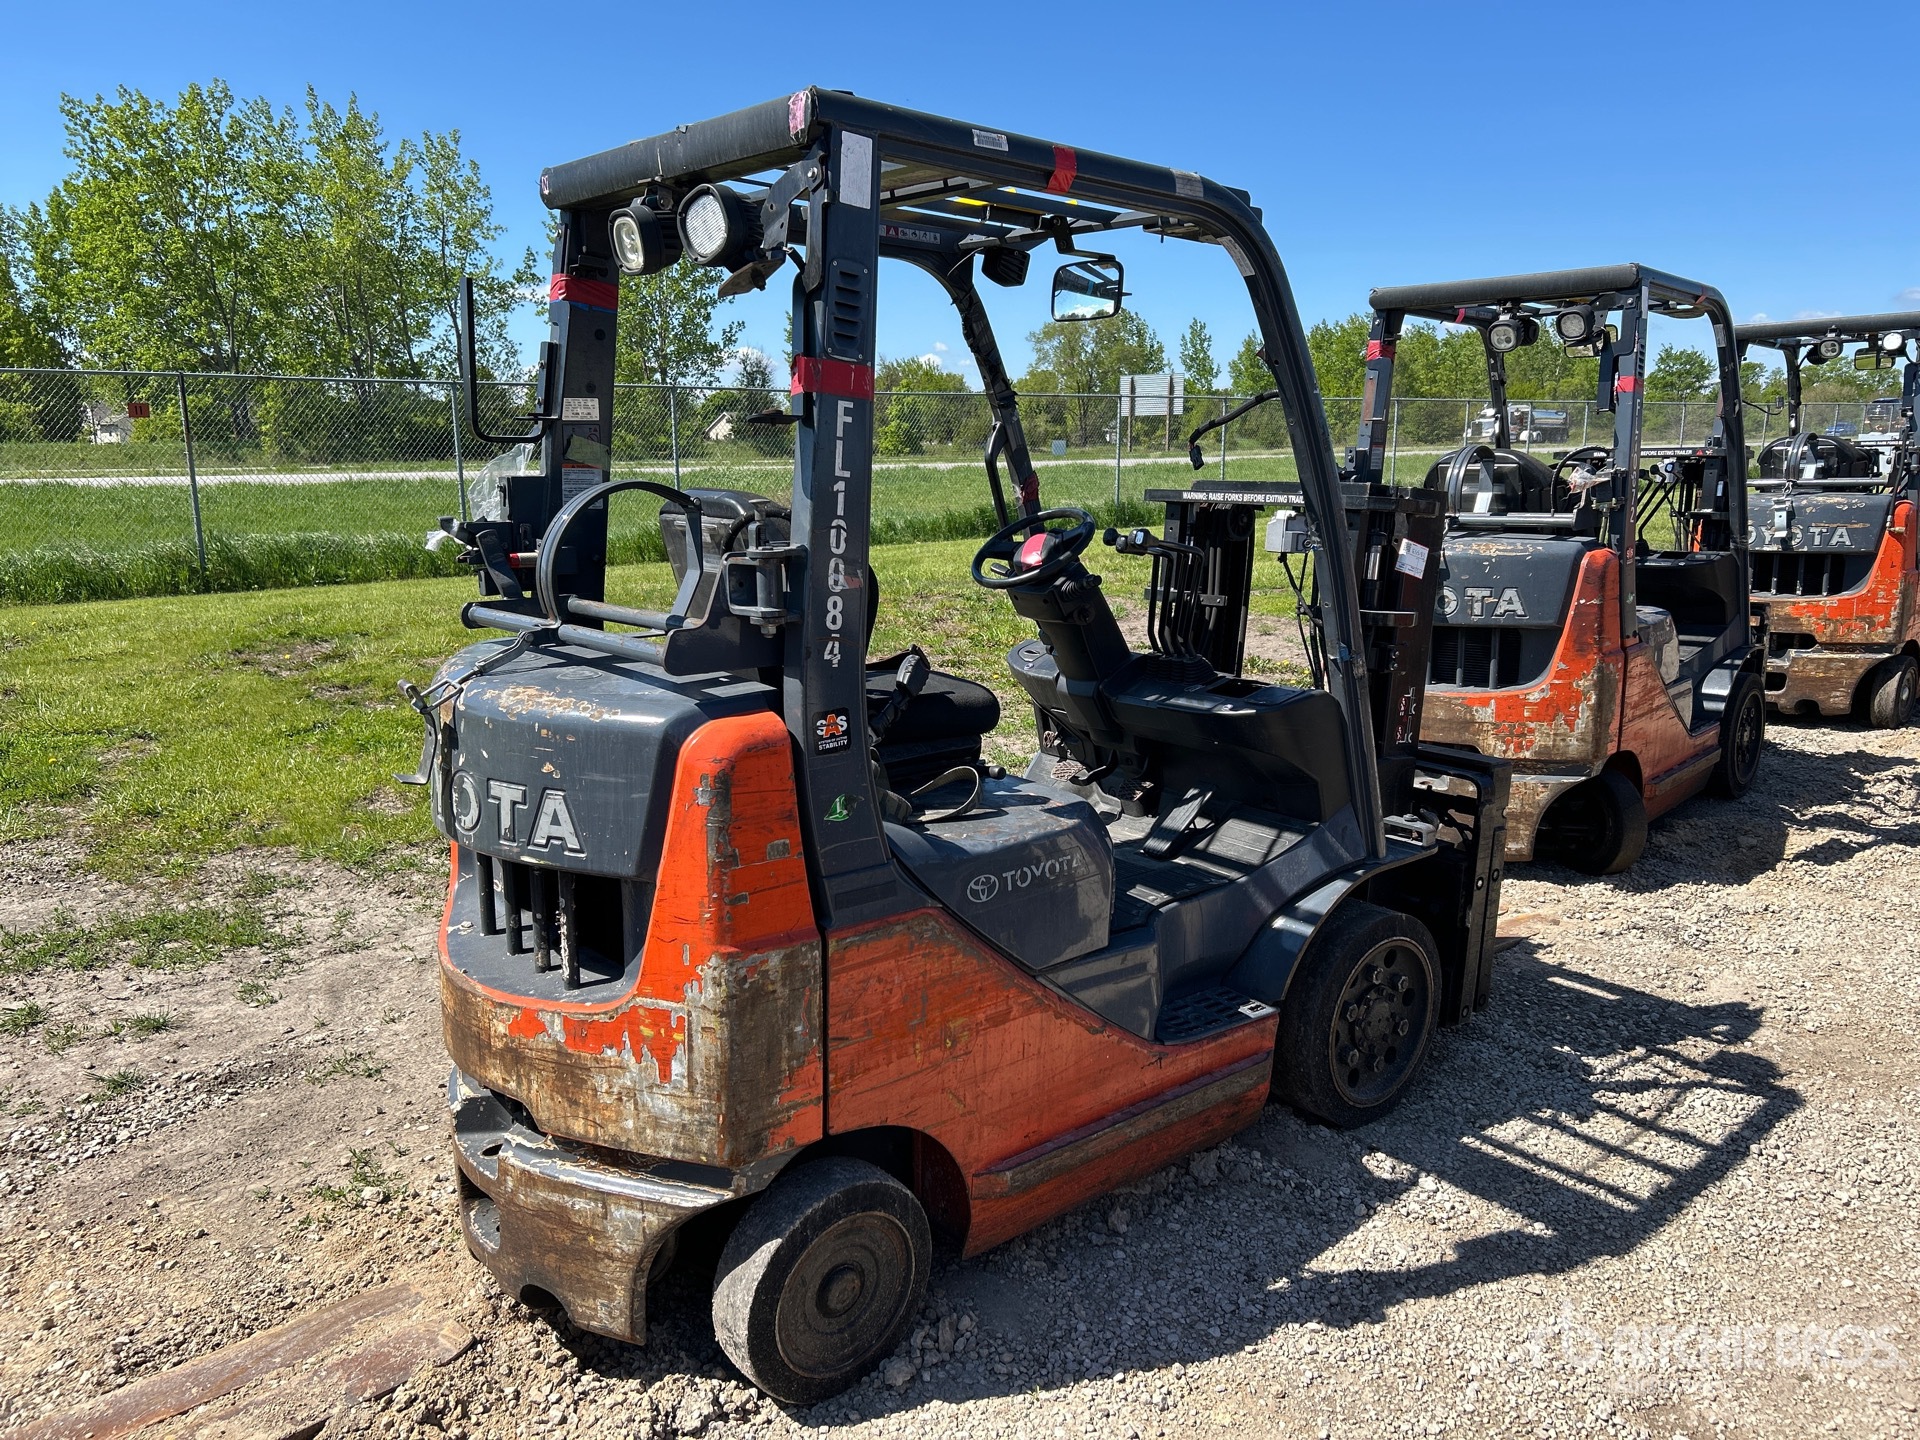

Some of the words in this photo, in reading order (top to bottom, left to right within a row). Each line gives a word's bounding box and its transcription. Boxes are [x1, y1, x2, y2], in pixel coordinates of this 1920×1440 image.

[1182, 491, 1208, 501] WARNING:
[1209, 492, 1224, 501] RAISE
[1225, 493, 1243, 502] FORKS
[1243, 494, 1265, 502] BEFORE
[1266, 494, 1287, 503] EXITING
[1288, 495, 1305, 504] TRAIL
[816, 714, 848, 738] SAS
[819, 740, 848, 750] STABILITY
[1002, 853, 1081, 892] TOYOTA
